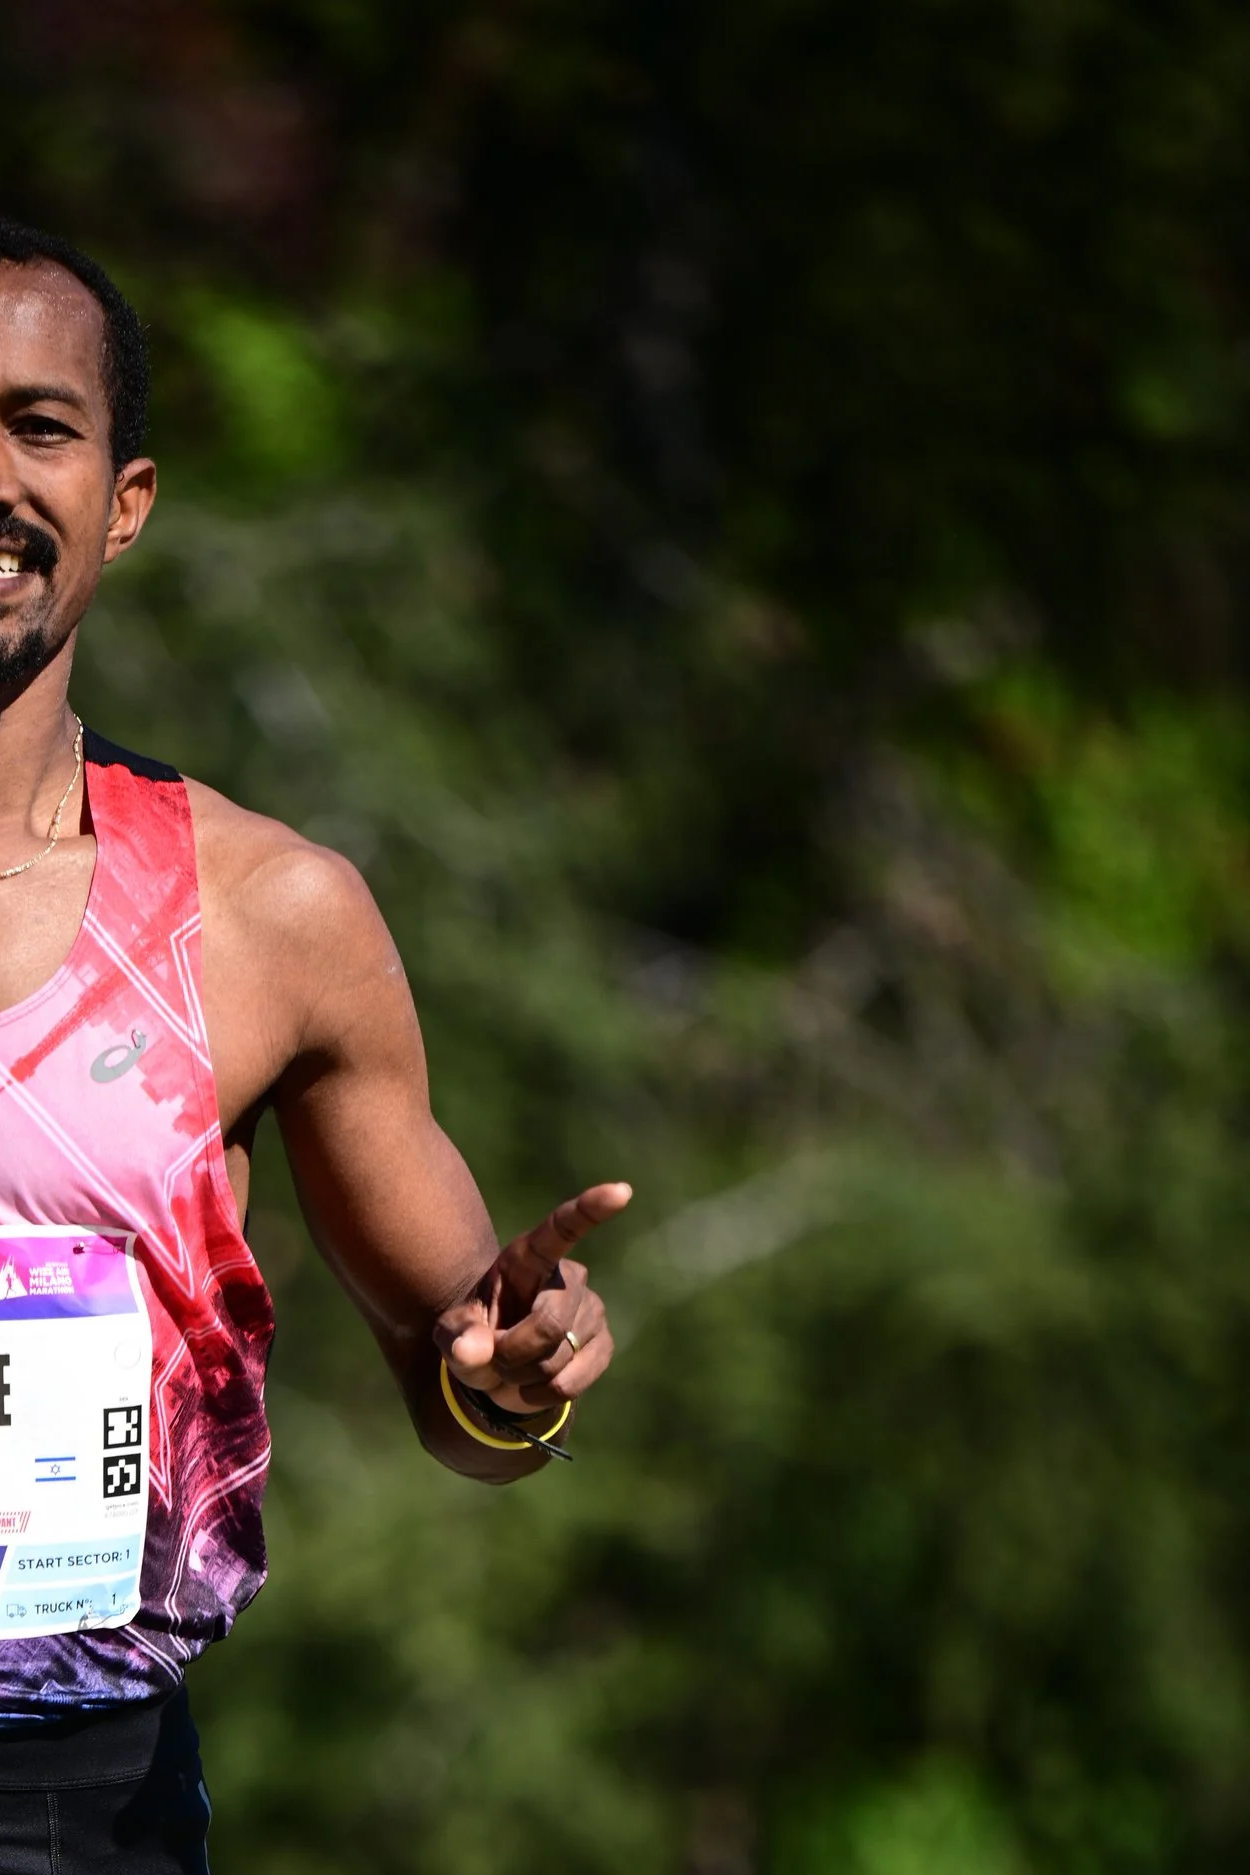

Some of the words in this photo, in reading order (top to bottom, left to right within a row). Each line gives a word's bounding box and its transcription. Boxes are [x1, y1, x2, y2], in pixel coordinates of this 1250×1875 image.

[29, 1276, 73, 1287] MILANO
[29, 1286, 75, 1295] MARATHON
[18, 1557, 63, 1571] START
[67, 1551, 124, 1567] SECTOR:
[126, 1549, 131, 1560] 1
[34, 1600, 73, 1615] TRUCK
[112, 1593, 117, 1606] 1
